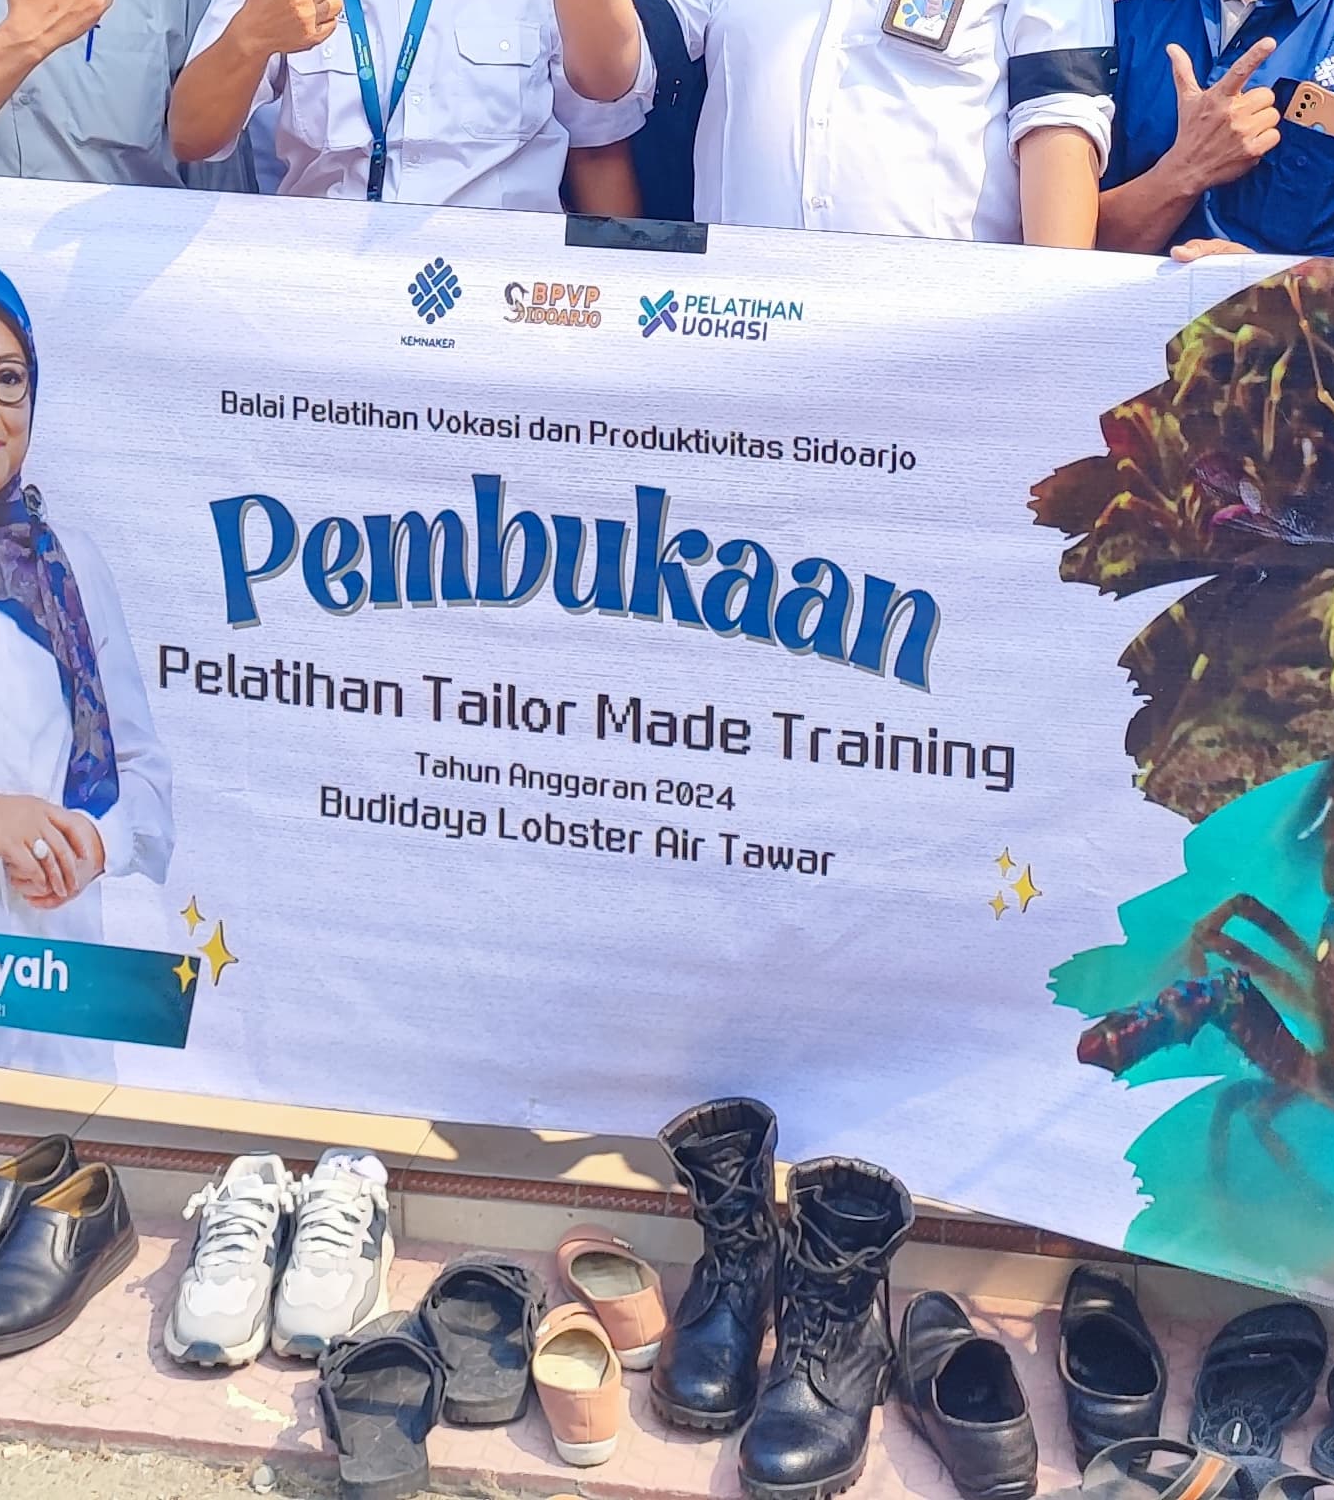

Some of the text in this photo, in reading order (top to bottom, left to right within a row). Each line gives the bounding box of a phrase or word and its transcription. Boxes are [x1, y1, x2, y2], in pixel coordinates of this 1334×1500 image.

[531, 282, 601, 308] BPVP
[682, 294, 804, 322] PELATIHAN
[399, 335, 457, 350] KEMNAKER
[681, 315, 769, 342] VOKASI
[221, 389, 917, 474] Balai Pelatihan Vokasi dan Produktivitas Sidoarjo
[209, 473, 942, 694] Pembukaan
[159, 643, 1017, 793] Pelatihan Tailor Made Training
[414, 751, 736, 812] Tahun Anggaran 2024
[319, 785, 836, 878] Budidaya Lobster Air Tawar
